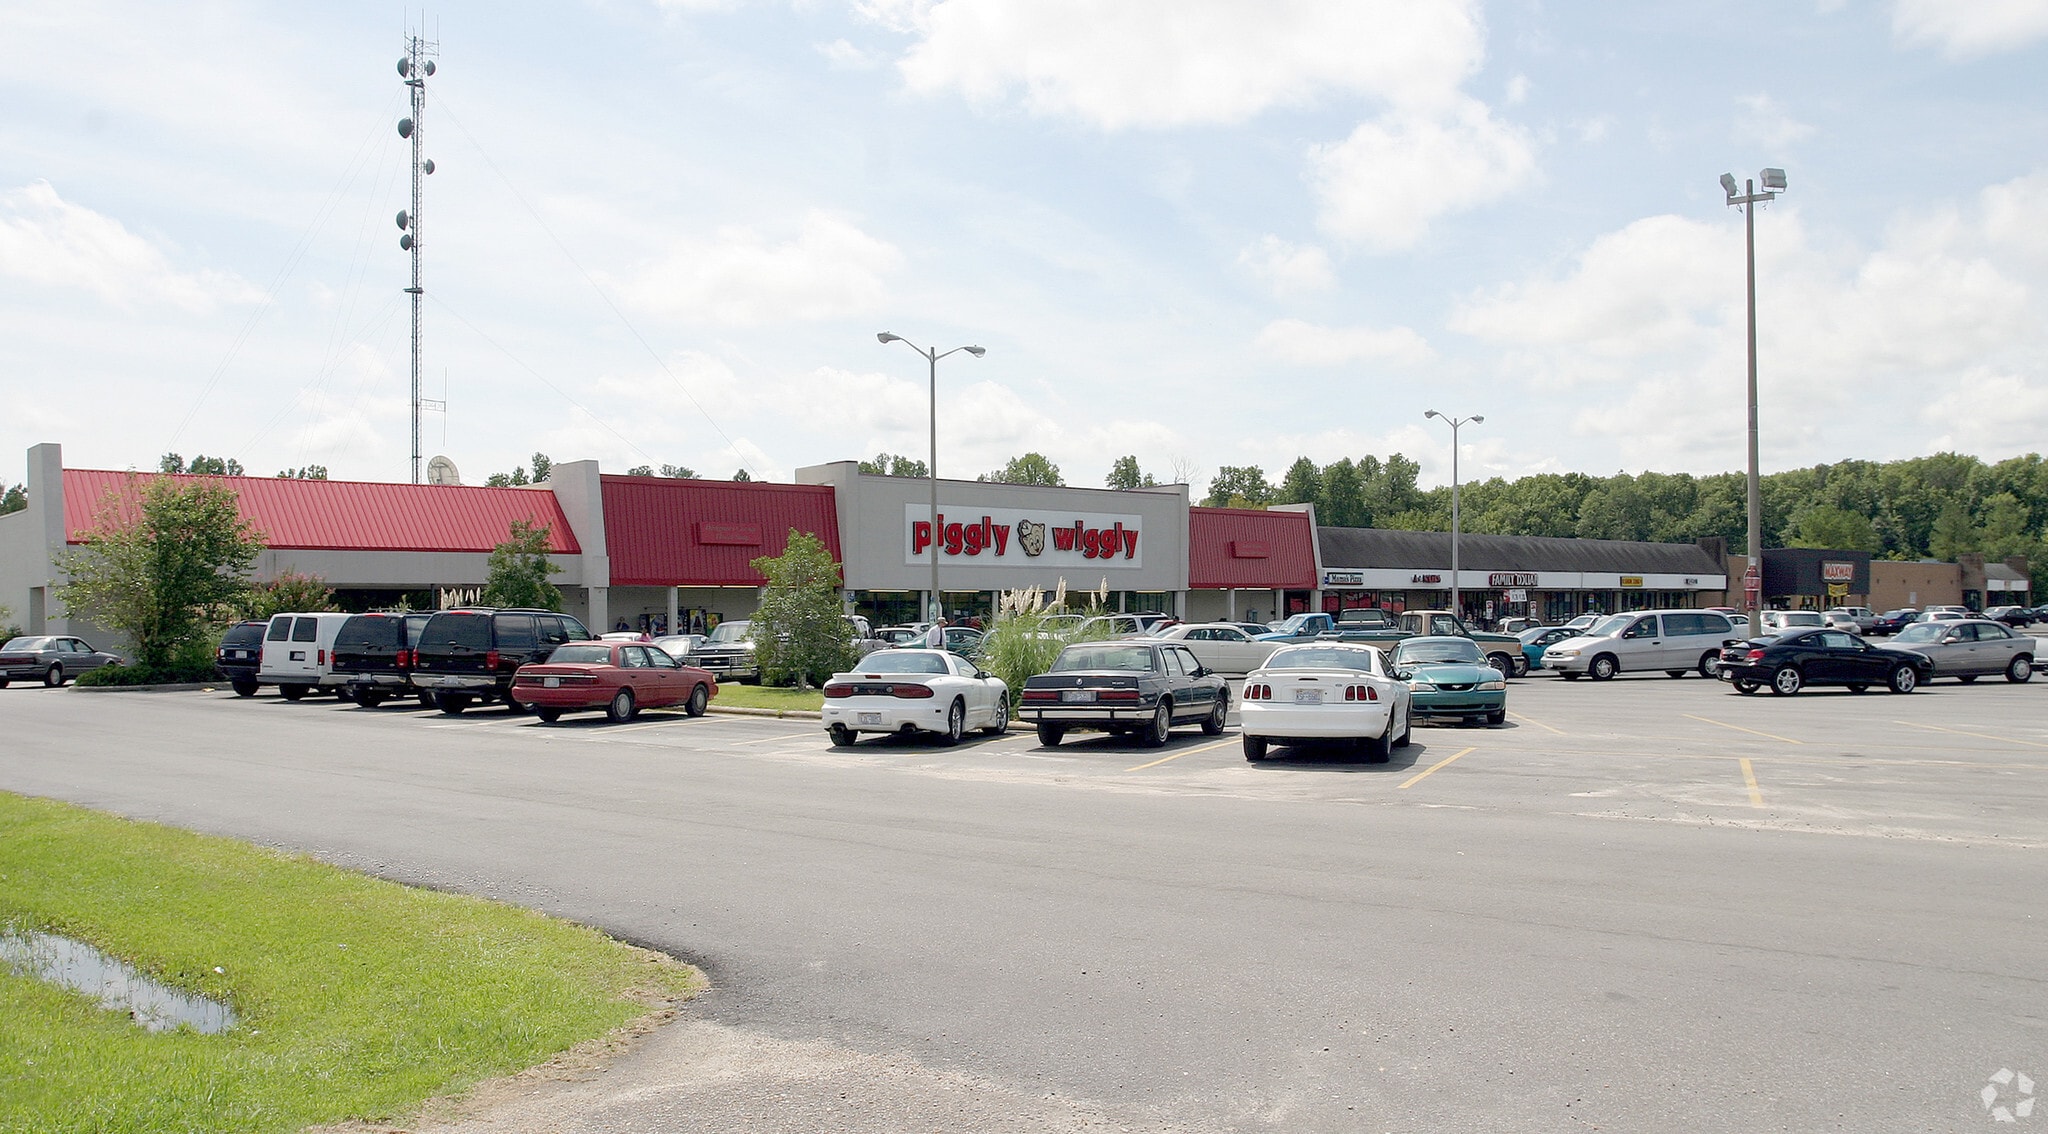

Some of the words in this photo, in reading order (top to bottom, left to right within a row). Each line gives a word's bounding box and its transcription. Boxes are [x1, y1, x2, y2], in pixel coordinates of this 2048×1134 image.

[912, 513, 1010, 556] piggly
[1052, 520, 1139, 559] wiggly
[1491, 573, 1515, 586] FAMILY
